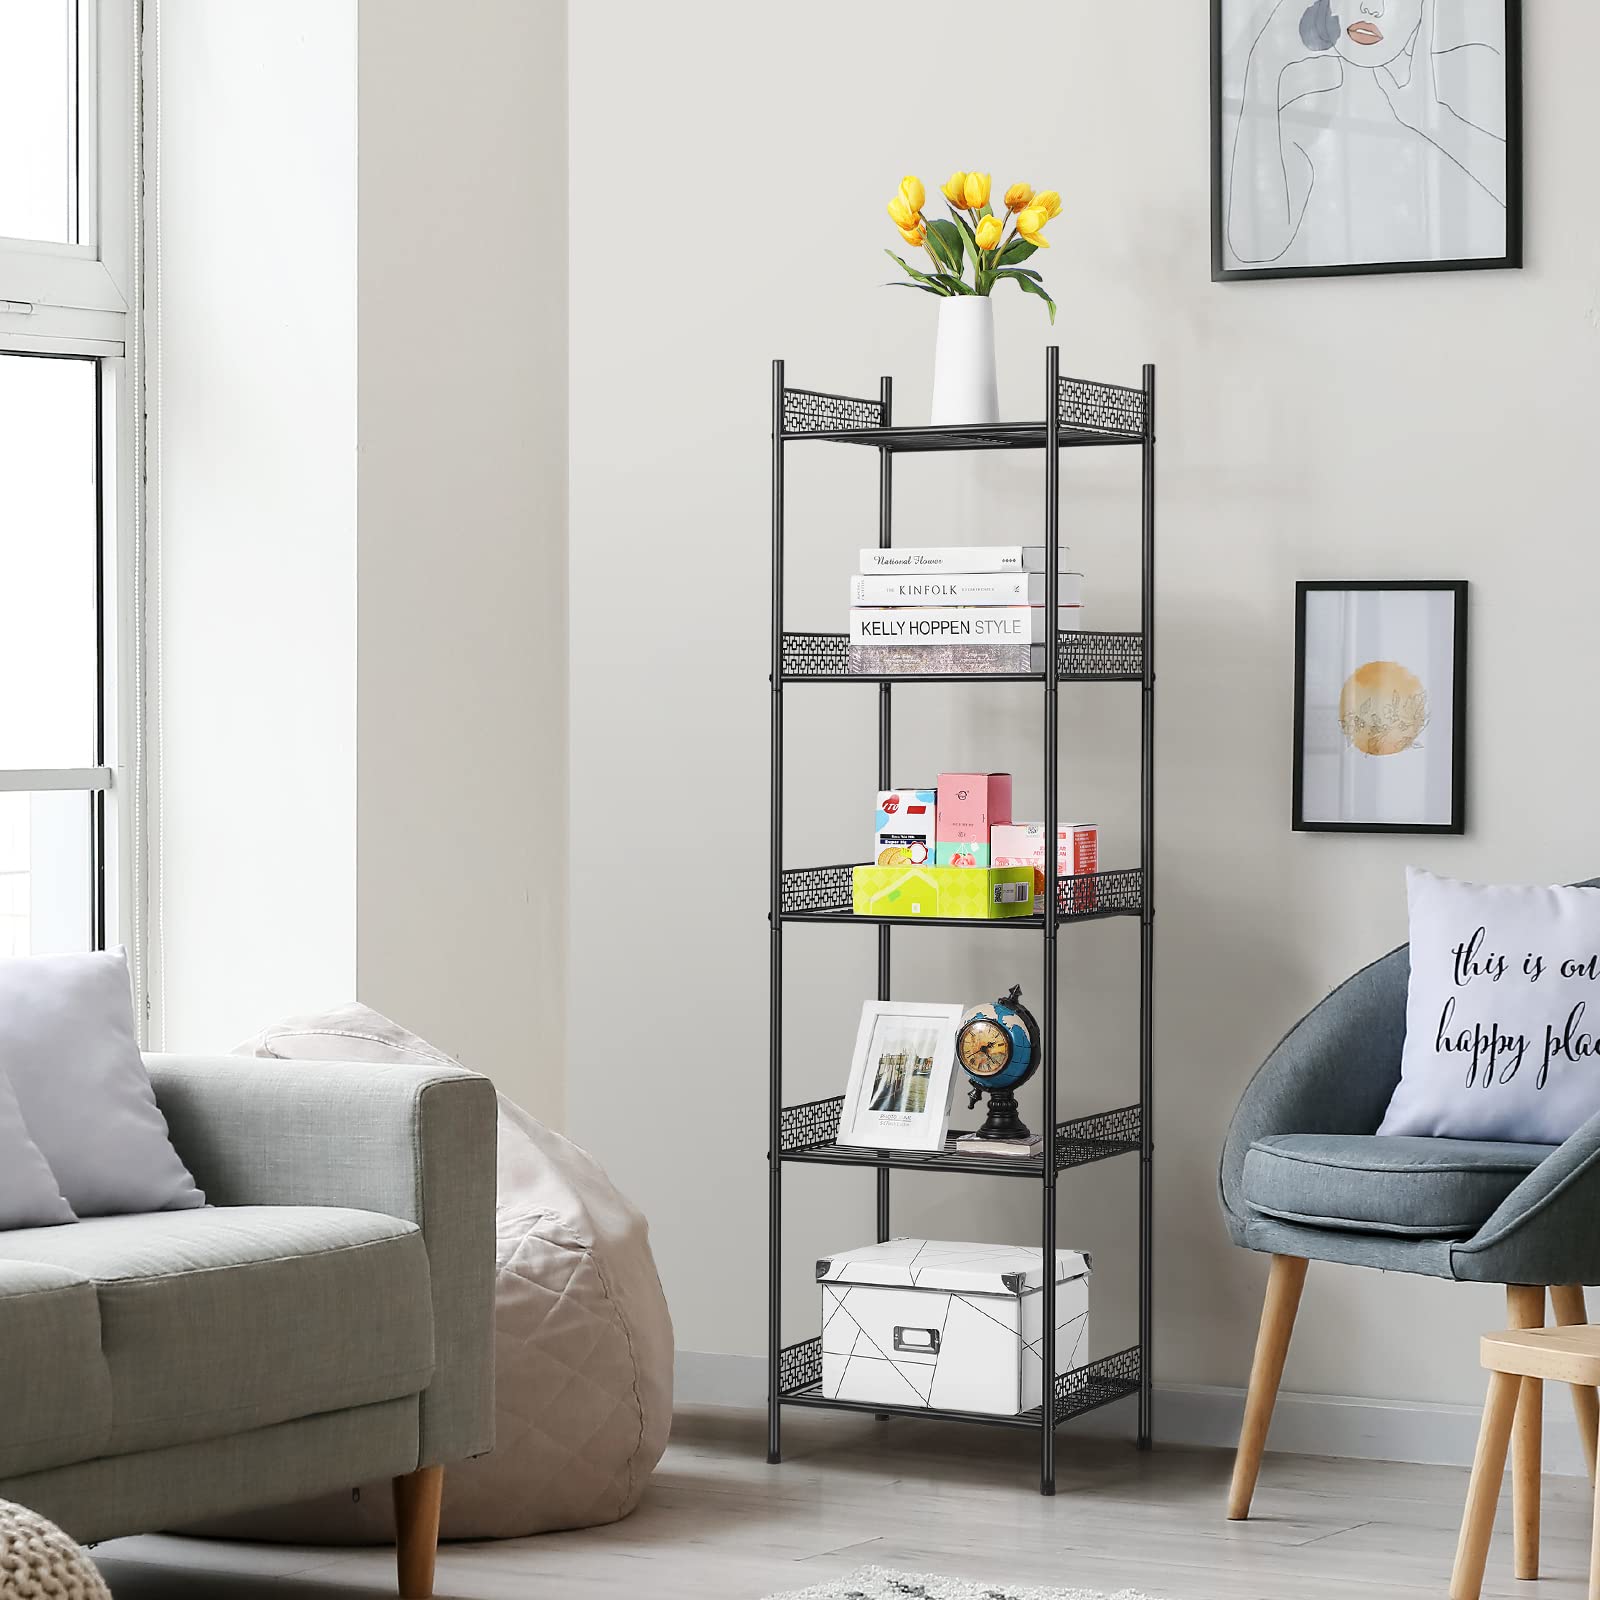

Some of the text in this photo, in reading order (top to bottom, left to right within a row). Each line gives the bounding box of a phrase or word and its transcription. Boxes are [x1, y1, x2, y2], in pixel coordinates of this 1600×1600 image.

[873, 555, 944, 565] National Flower
[899, 585, 957, 595] KINFOLK
[862, 619, 1022, 636] KELLY HOPPEN STYLE
[1451, 926, 1600, 986] this is ou
[1436, 996, 1531, 1089] happy
